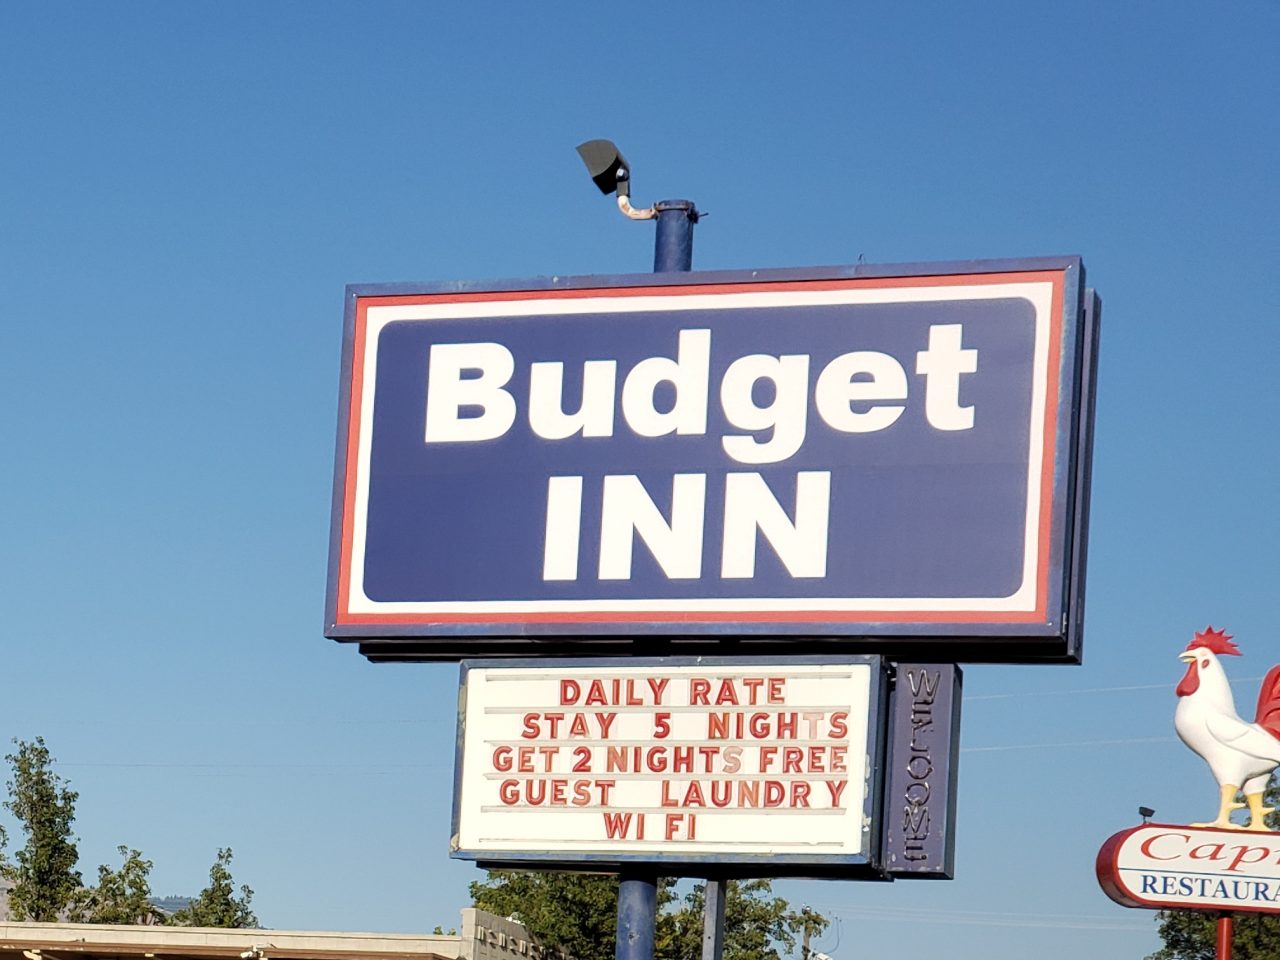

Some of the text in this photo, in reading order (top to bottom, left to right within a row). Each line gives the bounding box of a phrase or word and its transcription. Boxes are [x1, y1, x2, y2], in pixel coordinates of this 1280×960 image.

[424, 323, 978, 464] Budget
[543, 471, 831, 581] INN
[560, 677, 786, 706] DAILY RATE
[522, 711, 849, 740] STAY 5 NIGHTS
[492, 745, 848, 774] GET 2 NIGHTS FREE
[499, 778, 849, 808] GUEST LAUNDRY
[1140, 832, 1280, 873] Cap
